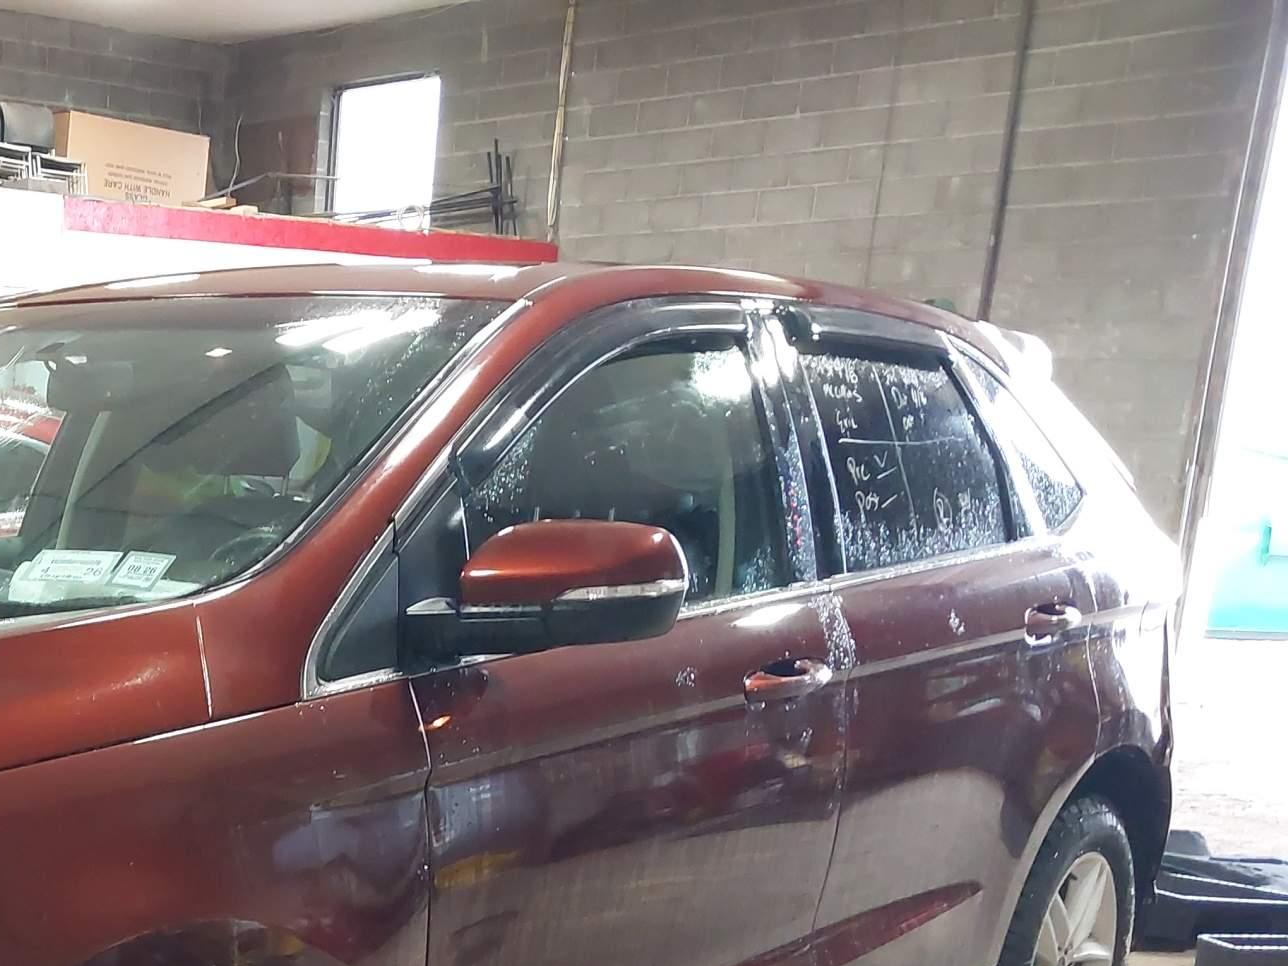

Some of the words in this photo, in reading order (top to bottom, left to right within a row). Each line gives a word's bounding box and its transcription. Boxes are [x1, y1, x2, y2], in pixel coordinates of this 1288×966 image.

[104, 178, 123, 190] CARE
[124, 182, 142, 193] WITH
[143, 186, 171, 198] HANDLE
